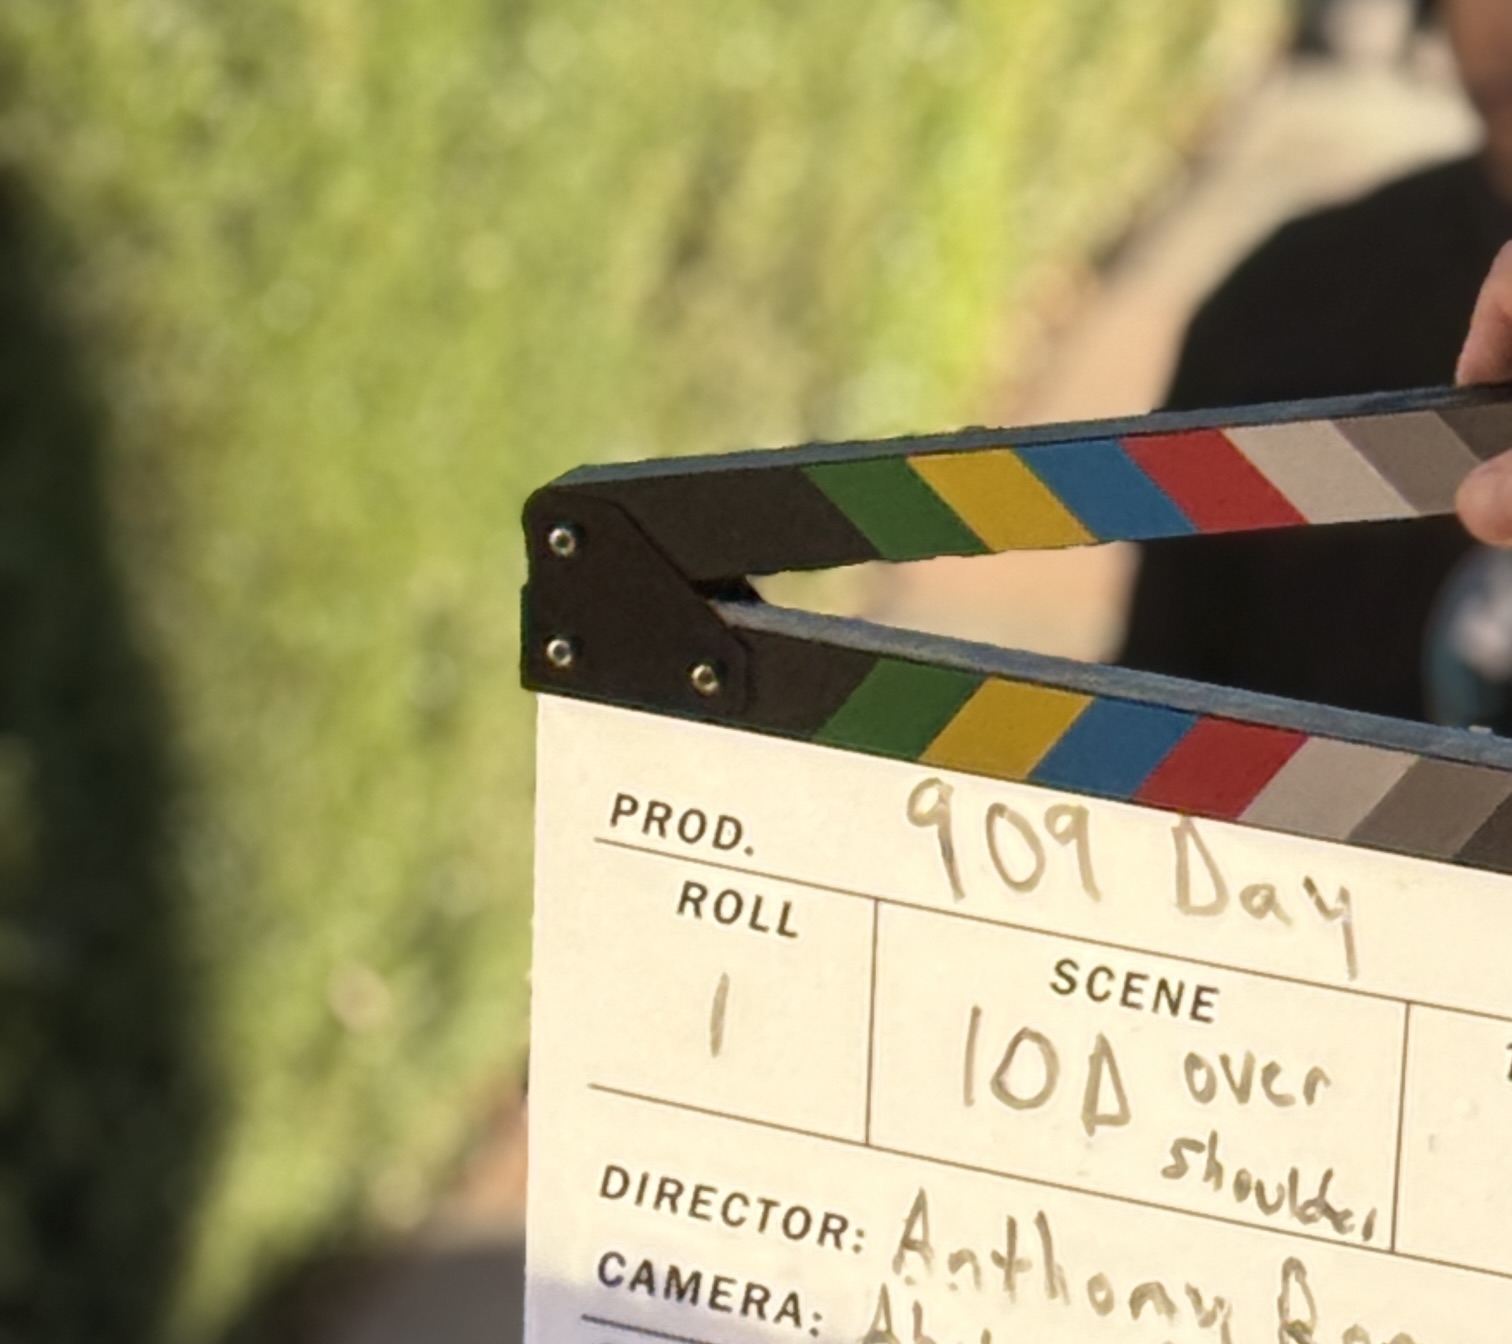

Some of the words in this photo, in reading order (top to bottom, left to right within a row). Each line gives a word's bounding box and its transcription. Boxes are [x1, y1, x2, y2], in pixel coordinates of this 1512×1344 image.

[609, 792, 755, 856] PROD.
[675, 880, 799, 939] ROLL
[906, 776, 1103, 902] 909
[1172, 812, 1358, 982] Day
[1050, 958, 1220, 1024] SCENE
[1183, 1051, 1332, 1107] over
[598, 1164, 866, 1255] DIRECTOR:
[596, 1250, 824, 1338] CAMERA:
